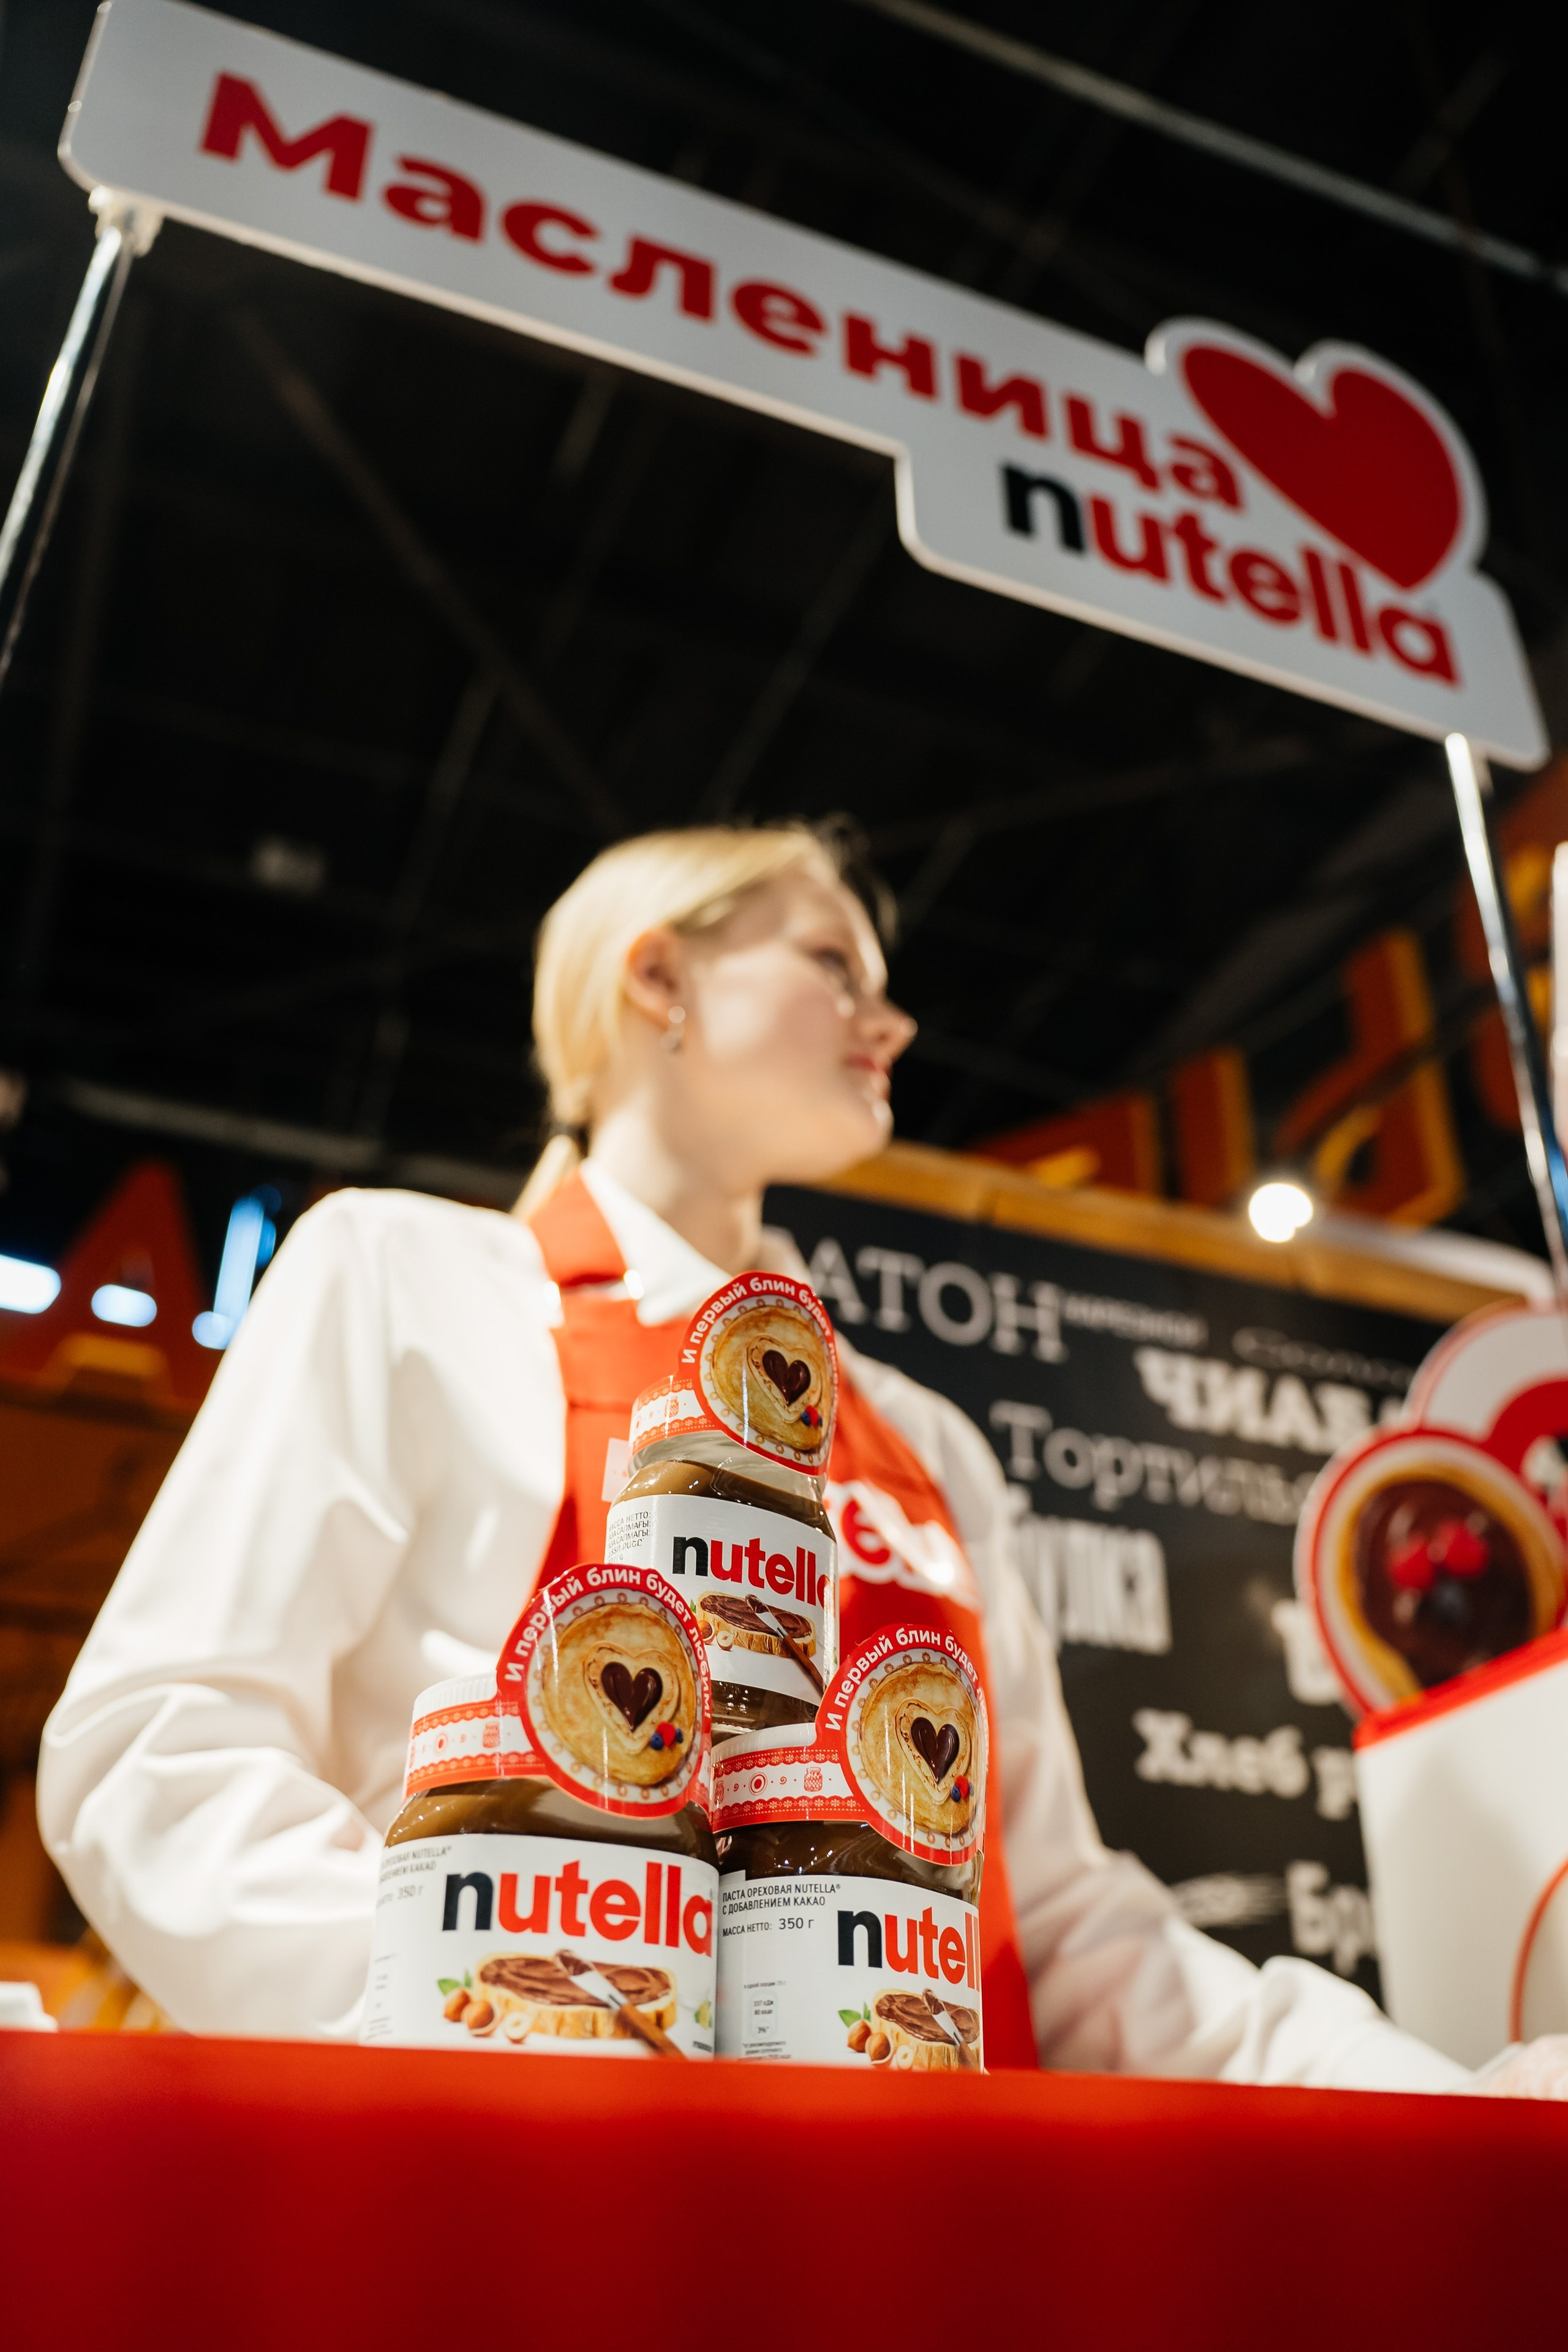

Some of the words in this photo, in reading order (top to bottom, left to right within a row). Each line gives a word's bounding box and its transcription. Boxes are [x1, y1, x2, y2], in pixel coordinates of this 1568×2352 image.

[199, 69, 1244, 513] Масленица
[1002, 461, 1461, 690] nutella
[682, 1349, 697, 1363] И
[690, 1283, 747, 1344] первый
[750, 1277, 795, 1296] блин
[807, 1237, 1069, 1363] АТОН
[1134, 1348, 1410, 1458] ЧИАБ
[505, 1662, 524, 1682] И
[515, 1575, 584, 1657] первый
[586, 1567, 641, 1586] блин
[646, 1574, 692, 1623] будет
[689, 1626, 711, 1719] любим!
[825, 1713, 843, 1730] И
[834, 1635, 894, 1708] первый
[895, 1627, 941, 1646] блин
[945, 1635, 979, 1683] будет
[442, 1860, 713, 1958] nutella
[723, 1889, 745, 1903] ПАСТА
[747, 1884, 792, 1898] ОРЕХОВАЯ
[723, 1905, 727, 1915] С
[728, 1897, 791, 1916] ДОБАВЛЕНИЕМ
[793, 1896, 826, 1906] КАКАО
[723, 1924, 745, 1937] МАССА
[747, 1921, 772, 1933] НЕТТО:
[778, 1917, 804, 1930] 350
[808, 1918, 815, 1929] г
[837, 1906, 980, 1992] nutell
